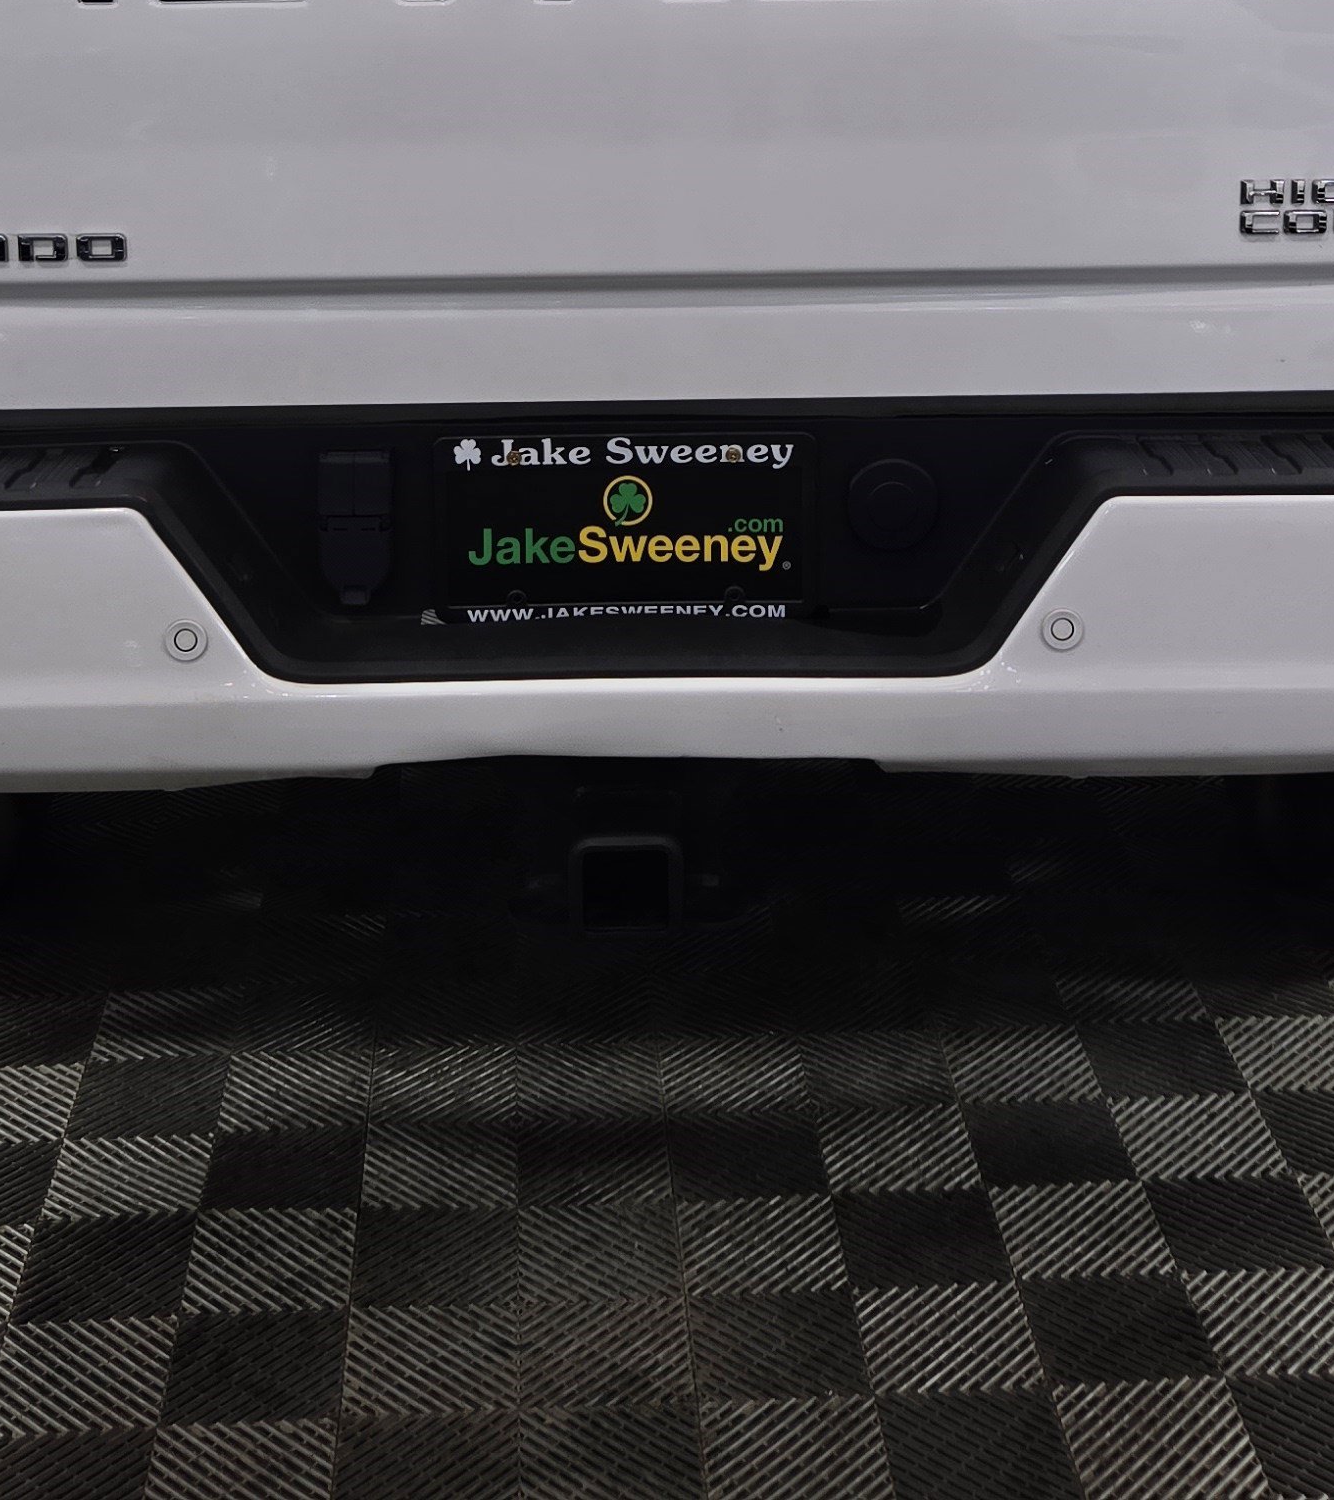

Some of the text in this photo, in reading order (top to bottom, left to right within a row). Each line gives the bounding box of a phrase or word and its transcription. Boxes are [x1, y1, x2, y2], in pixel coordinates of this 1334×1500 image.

[491, 437, 795, 470] Jake Sweeney
[468, 525, 783, 572] JakeSweeney
